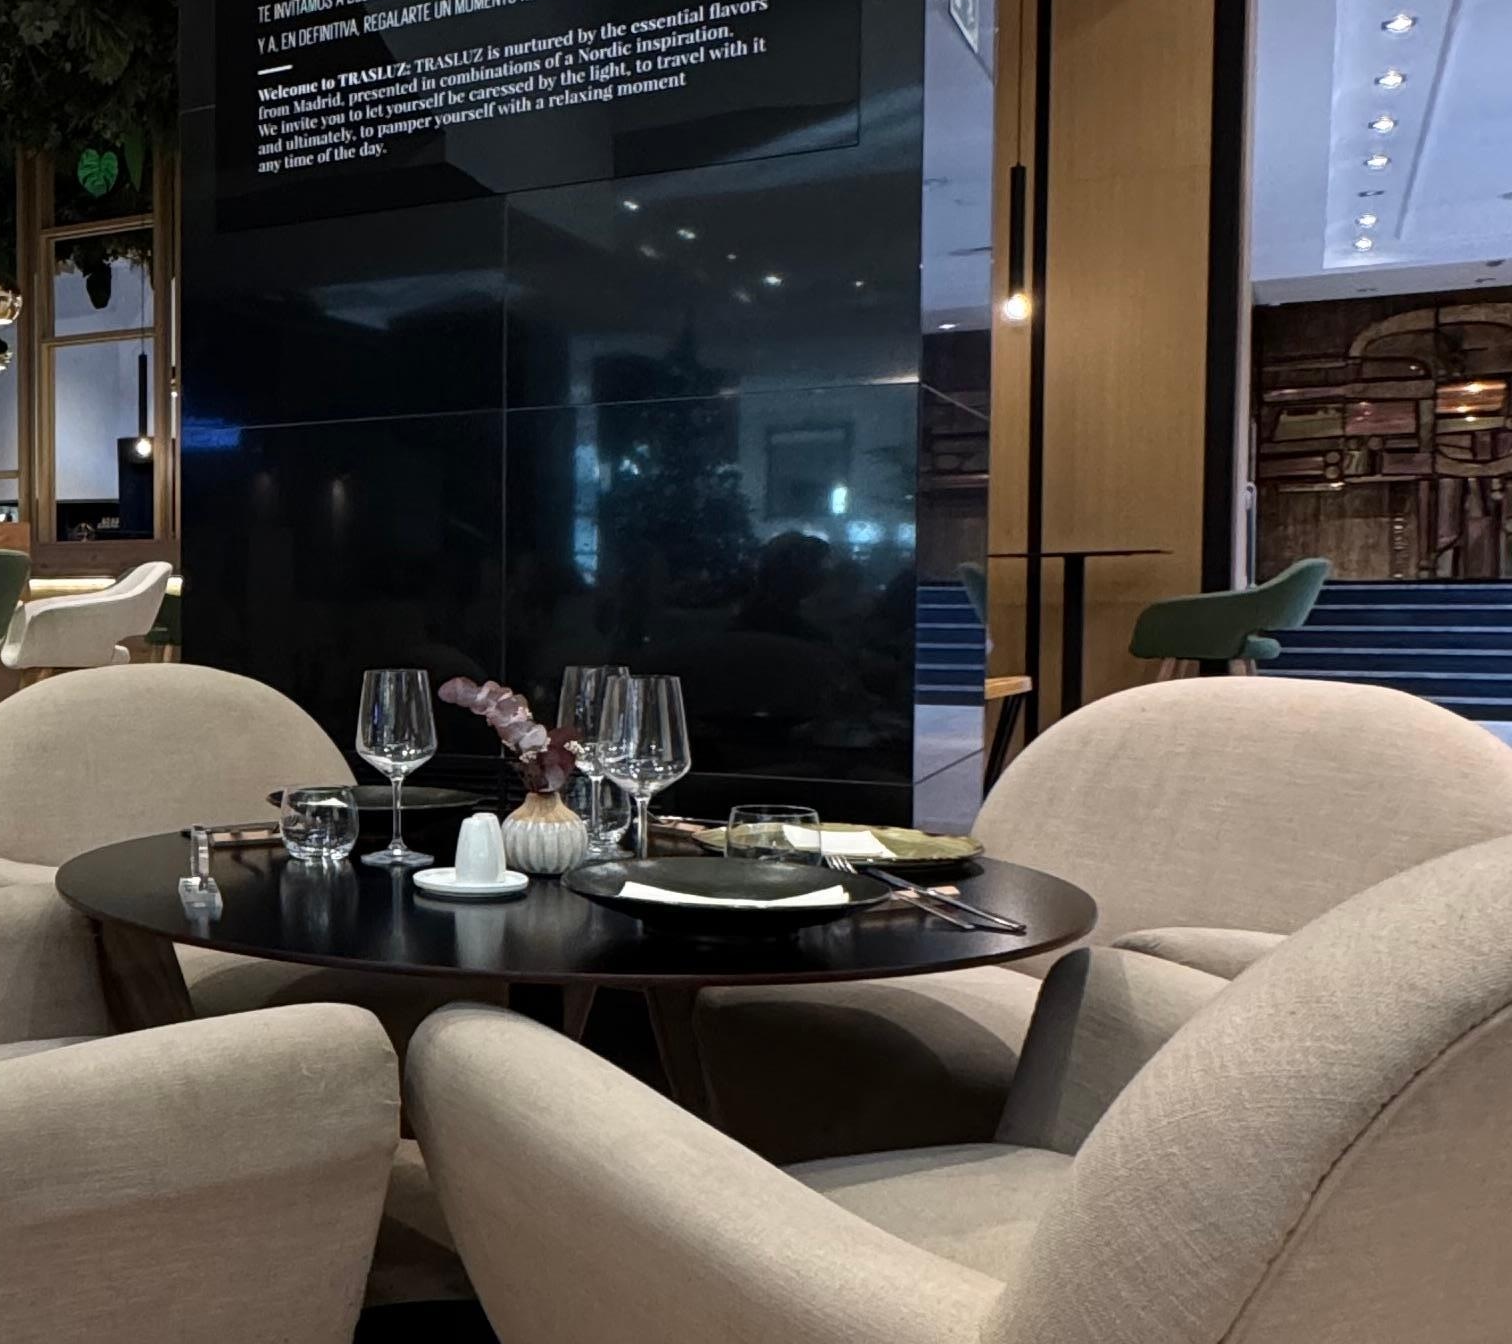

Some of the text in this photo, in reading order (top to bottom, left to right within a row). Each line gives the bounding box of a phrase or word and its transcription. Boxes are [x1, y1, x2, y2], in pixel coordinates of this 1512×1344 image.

[258, 6, 271, 24] TE
[258, 38, 266, 55] Y
[282, 33, 295, 50] EN
[364, 2, 431, 33] REGALARTE
[258, 80, 318, 102] Welcome
[322, 77, 335, 91] to
[338, 62, 411, 88] TRASLUZ:
[414, 48, 483, 73] TRASLUZ
[488, 46, 500, 61] is
[504, 30, 573, 58] nurtured
[578, 26, 598, 44] by
[601, 22, 626, 39] the
[631, 6, 704, 35] essential
[258, 103, 290, 120] from
[349, 79, 417, 106] presented
[422, 77, 435, 91] in
[440, 61, 540, 88] combinations
[545, 52, 563, 69] of
[565, 53, 573, 65] a
[579, 41, 631, 64] Nordic
[258, 37, 766, 138] We invite you to let yourself be caressed by the light, to travel with it
[258, 141, 282, 155] and
[360, 125, 374, 138] to
[378, 117, 431, 138] pamper
[434, 101, 495, 128] yourself
[499, 98, 531, 114] with
[536, 98, 544, 109] a
[548, 83, 613, 107] relaxing
[617, 72, 687, 97] moment
[258, 141, 387, 173] any time of the day.
